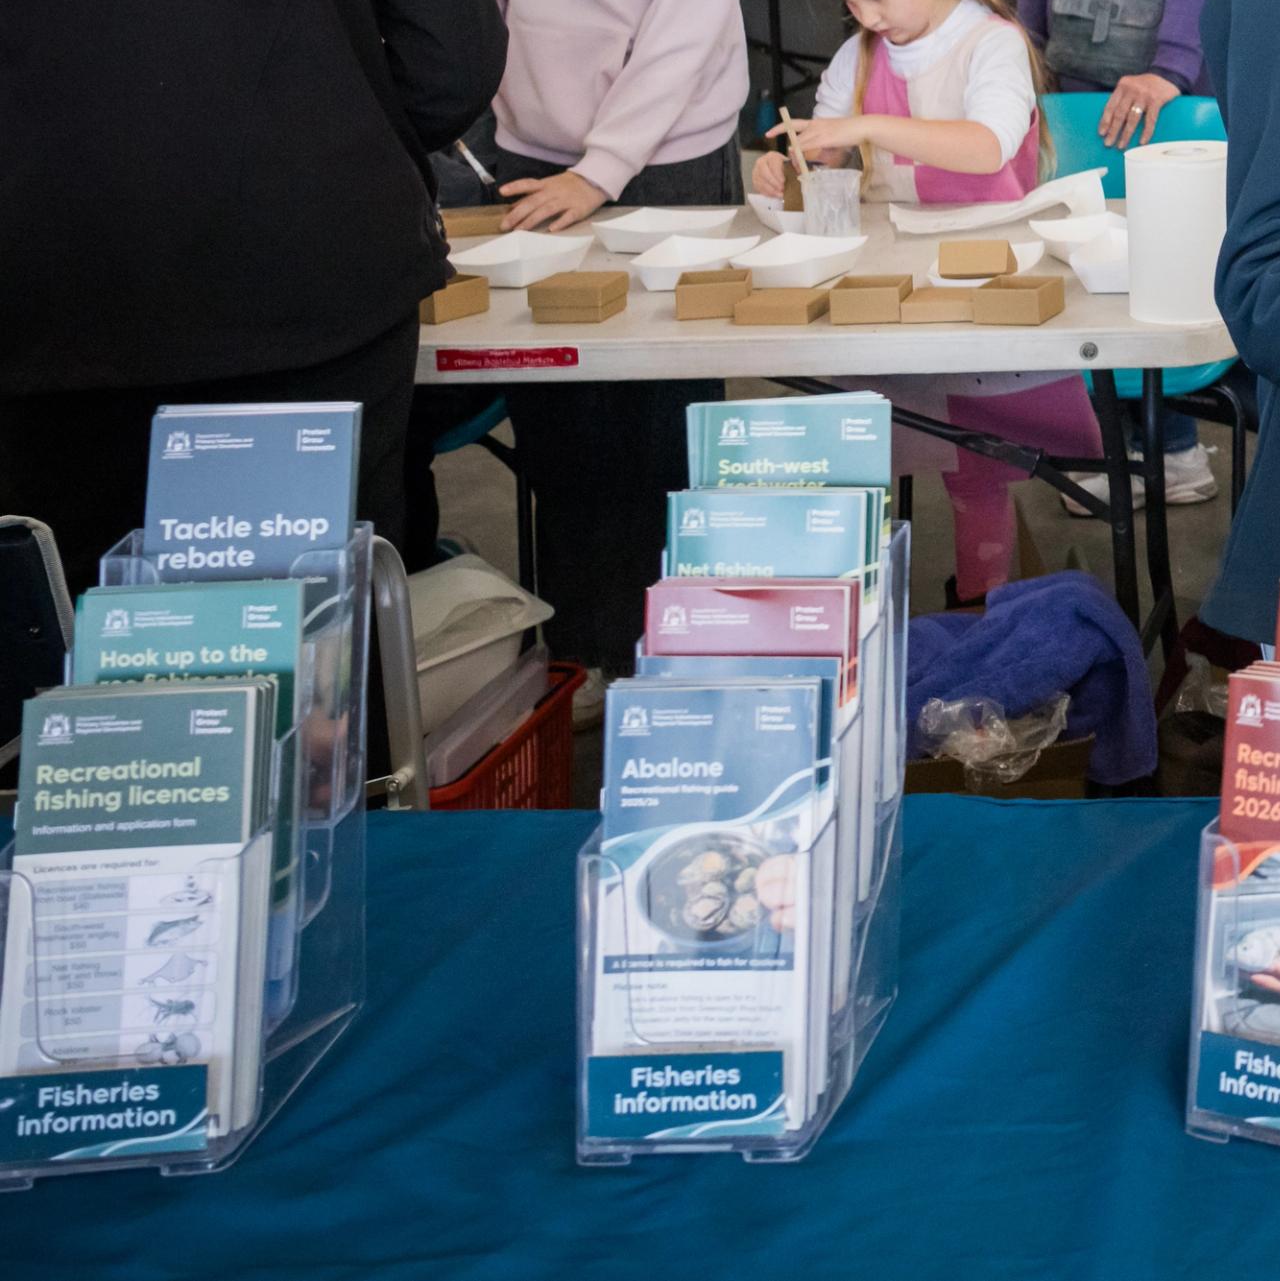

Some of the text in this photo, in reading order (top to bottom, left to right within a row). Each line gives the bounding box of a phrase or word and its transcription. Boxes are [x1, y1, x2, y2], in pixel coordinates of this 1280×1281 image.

[718, 458, 829, 476] South-west
[160, 513, 329, 541] Tackle shop
[158, 546, 255, 570] rebate
[678, 563, 774, 577] Net fishing
[100, 644, 267, 669] Hook up to the
[36, 756, 201, 785] Recreational
[621, 757, 723, 779] Abalone
[35, 785, 230, 812] fishing licences
[33, 823, 91, 836] Information
[95, 822, 114, 832] and
[117, 819, 171, 832] application
[631, 1065, 740, 1088] Fisheries
[38, 1081, 159, 1108] Fisheries
[614, 1090, 756, 1114] information
[17, 1108, 176, 1136] information
